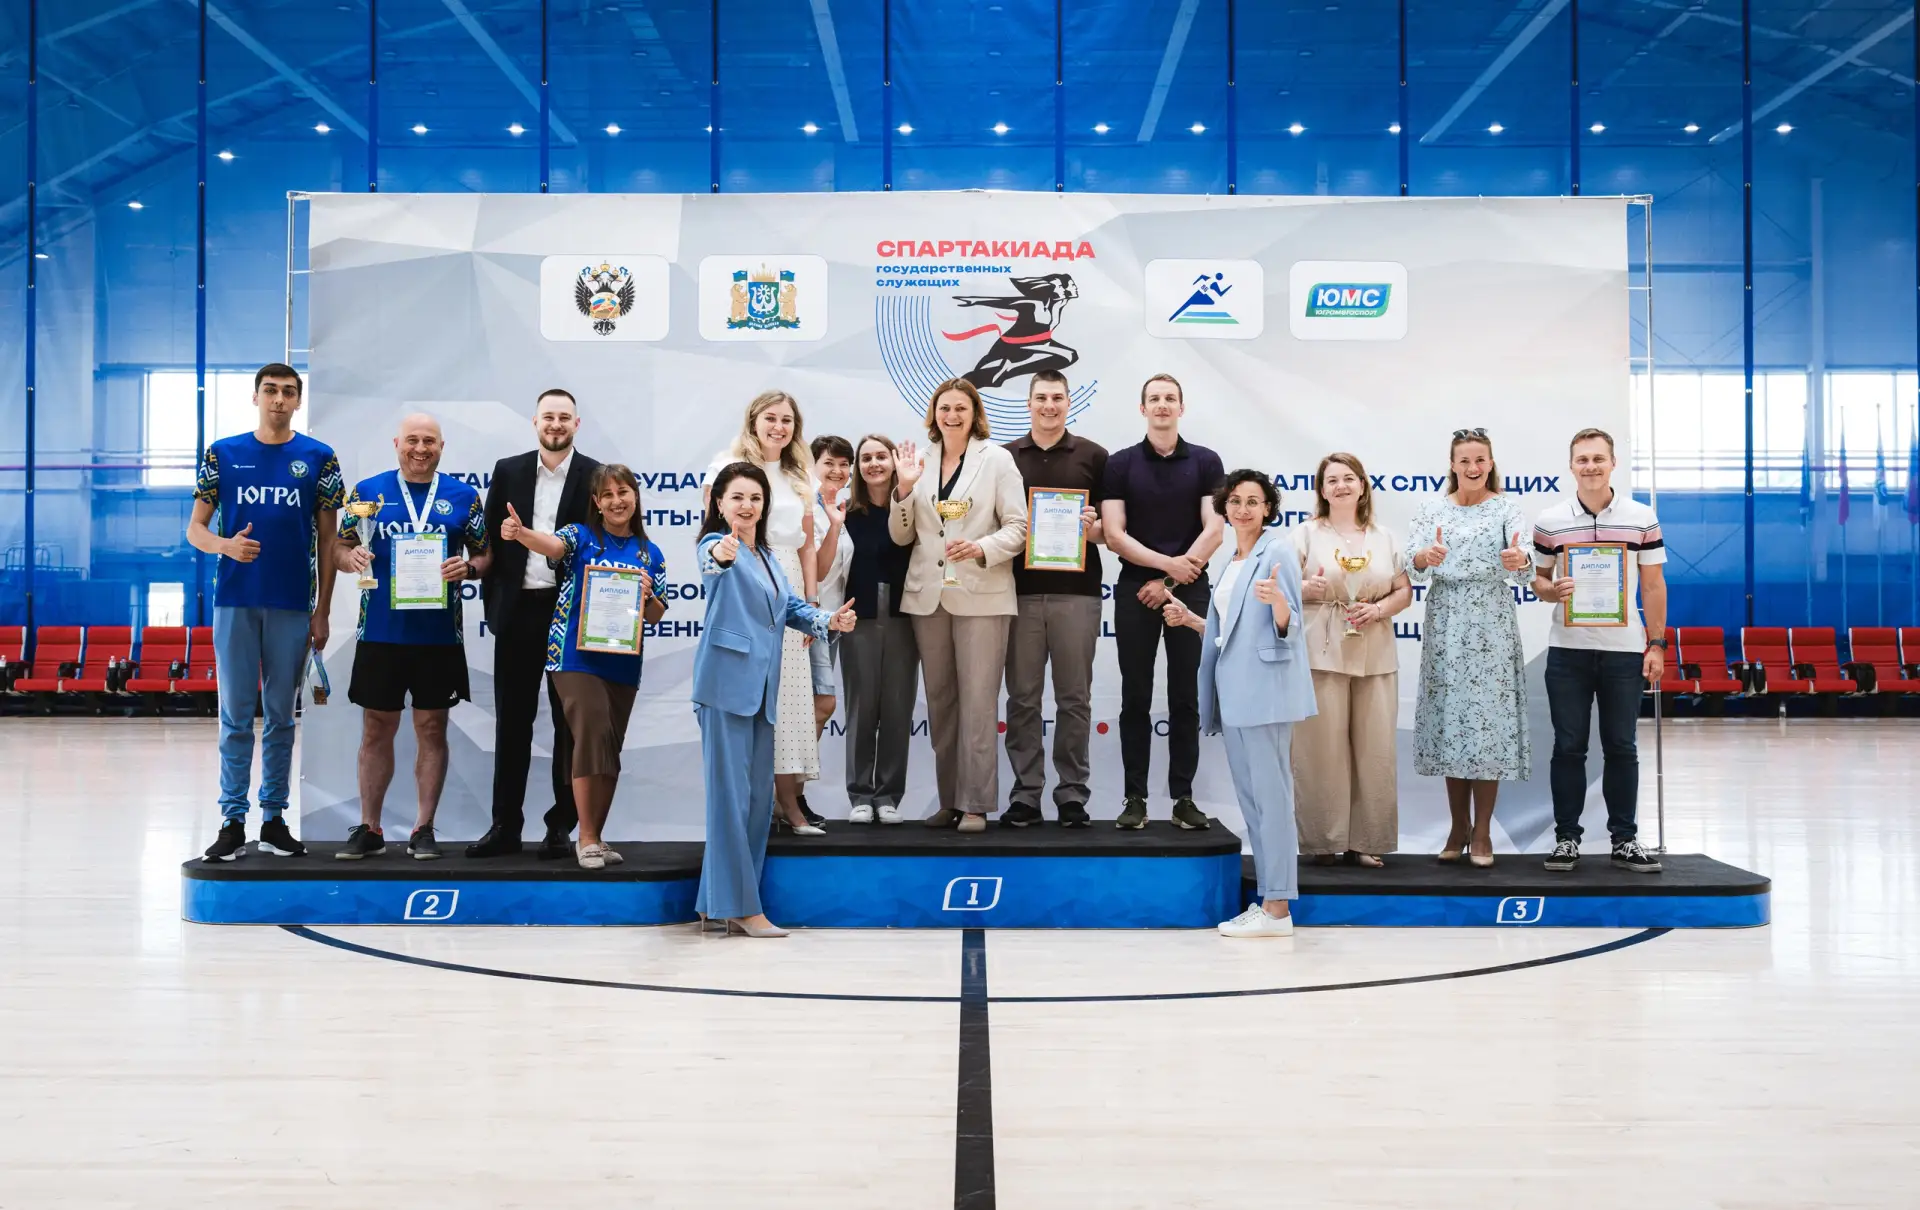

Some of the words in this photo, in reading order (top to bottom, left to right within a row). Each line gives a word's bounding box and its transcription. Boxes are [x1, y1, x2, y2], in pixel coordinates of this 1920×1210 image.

[876, 240, 1096, 261] СПАРТАКИАДА
[876, 264, 1012, 275] государственных
[876, 278, 960, 288] служащих
[1316, 288, 1380, 307] ЮМС
[237, 485, 301, 508] ЮГРА
[599, 586, 630, 595] ДИПЛОМ
[966, 882, 979, 905] 1
[422, 894, 440, 915] 2
[1512, 900, 1528, 920] 3
